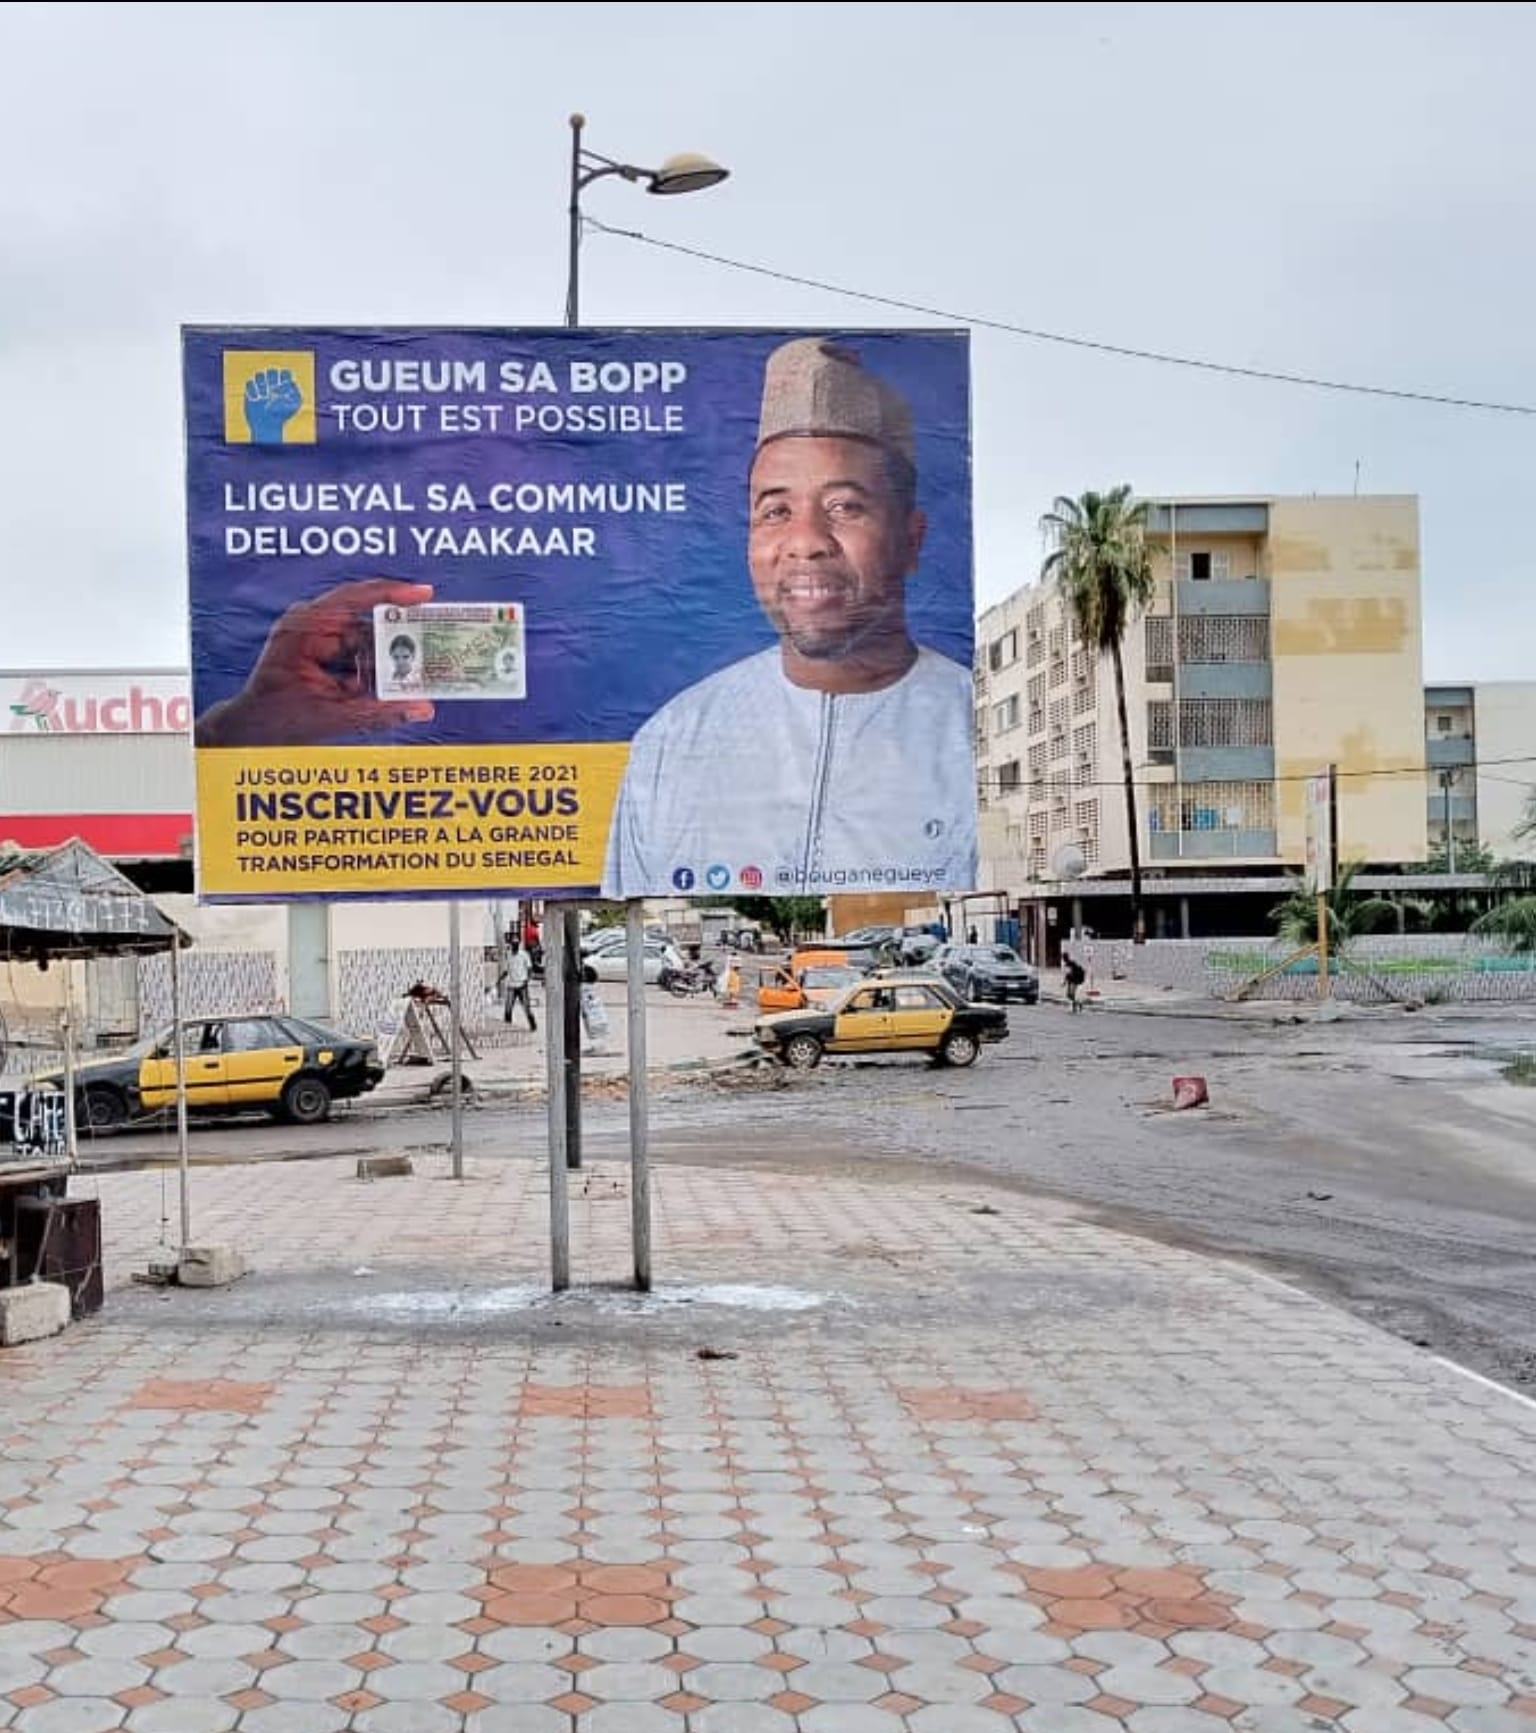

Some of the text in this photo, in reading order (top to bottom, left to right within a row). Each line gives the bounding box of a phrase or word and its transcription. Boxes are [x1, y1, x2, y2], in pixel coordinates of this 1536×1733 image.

[330, 360, 686, 393] GUEUM SA BOPP
[331, 404, 683, 432] TOUT EST POSSIBLE
[225, 483, 686, 513] LIGUEYAL SA COMMUNE
[225, 526, 595, 555] DELOOSI YAAKAAR
[235, 765, 577, 786] JUSQU'AU 14 SEPTEMBRE 2021
[236, 787, 579, 822] INSCRIVEZ-VOUS
[237, 825, 579, 847] POUR PARTICIPER A LA GRANDE
[236, 850, 580, 872] TRANSFORMATION DU SENEGAL
[775, 865, 947, 886] @bouganegueye
